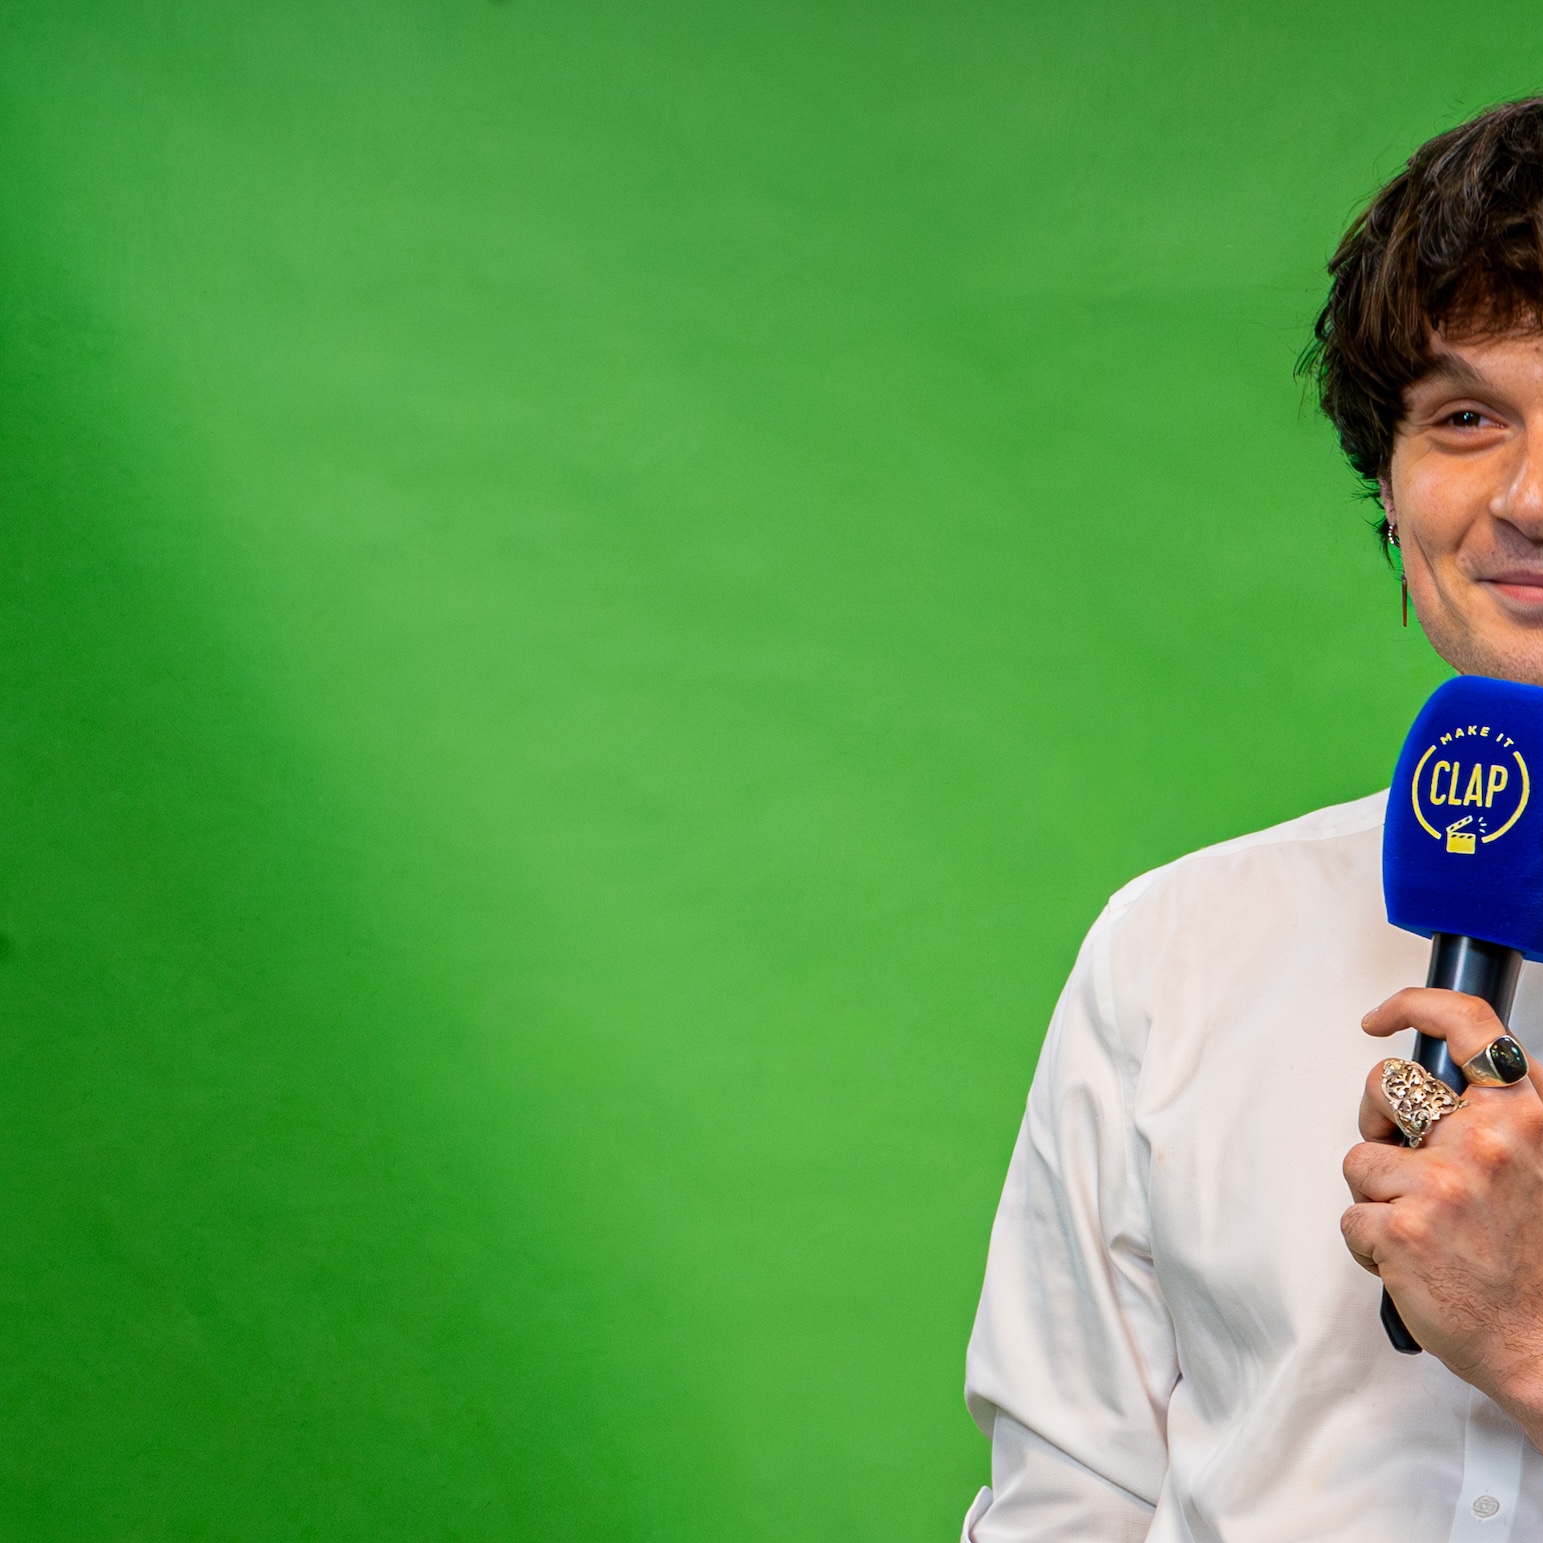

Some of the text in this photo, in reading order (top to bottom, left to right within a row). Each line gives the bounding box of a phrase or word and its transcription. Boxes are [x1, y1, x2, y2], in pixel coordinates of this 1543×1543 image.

[1440, 725, 1515, 748] MAKE IT
[1429, 760, 1509, 809] CLAP
